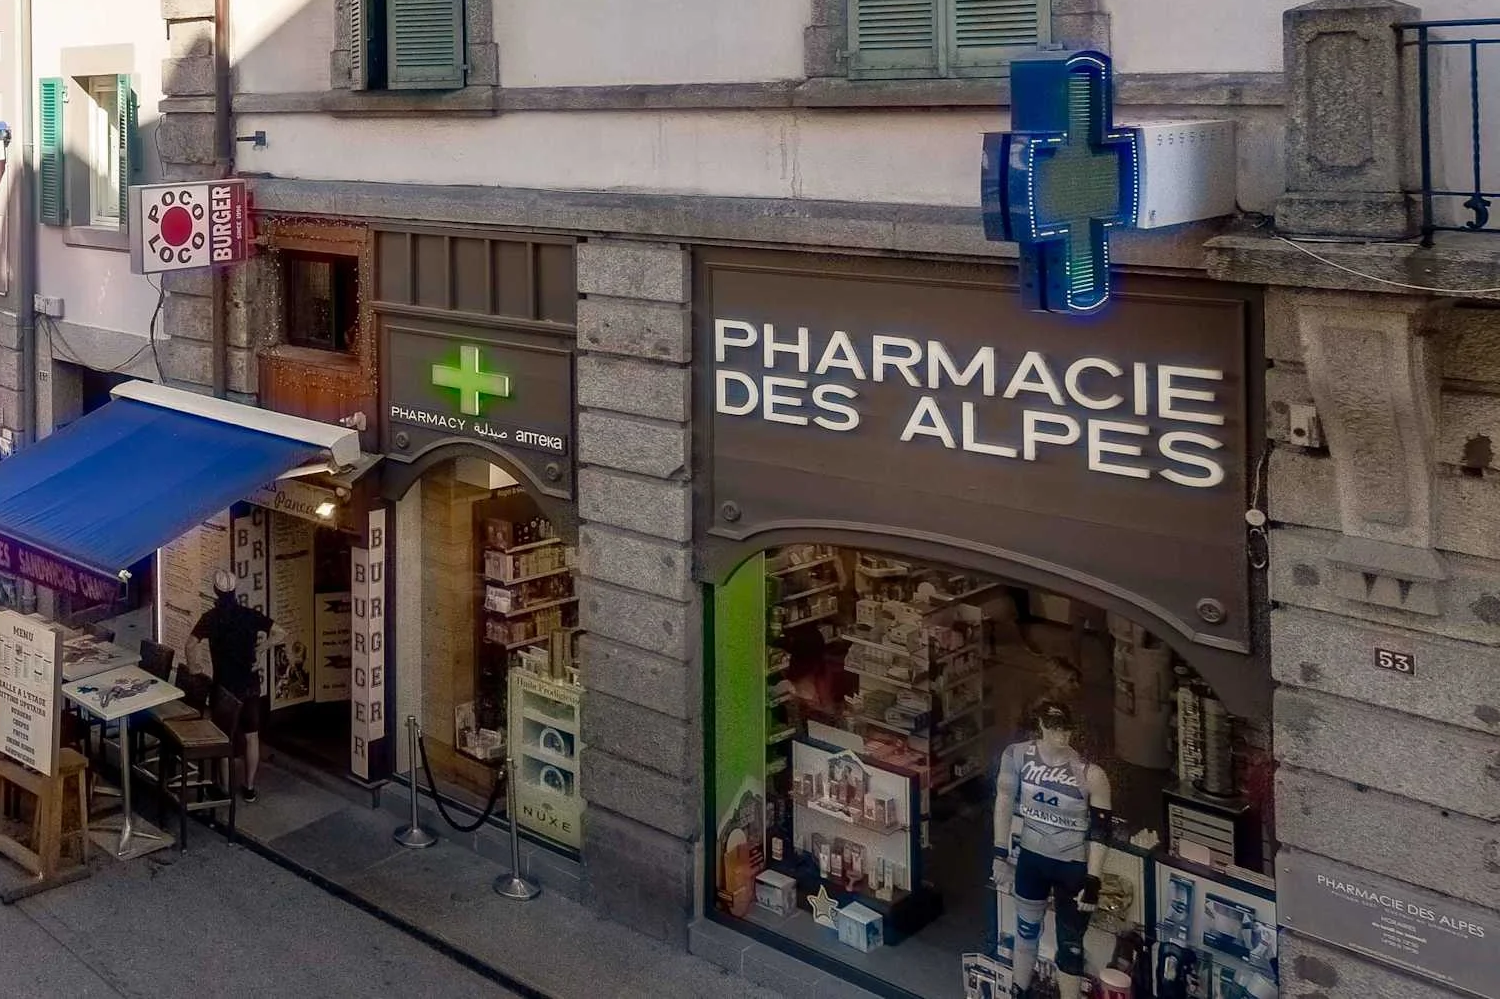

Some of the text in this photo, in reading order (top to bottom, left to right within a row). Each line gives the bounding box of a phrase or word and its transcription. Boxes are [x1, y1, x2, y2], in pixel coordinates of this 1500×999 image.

[148, 190, 204, 224] POCO
[212, 186, 233, 261] BURGER
[148, 232, 205, 263] LOCO
[714, 318, 1225, 426] PHARMACIE
[391, 406, 466, 431] PHARMACY
[715, 368, 1225, 488] DES ALPES
[515, 430, 563, 450] аптека
[13, 625, 34, 642] MENU
[370, 527, 382, 723] BURGER
[354, 563, 366, 757] BURGER
[1379, 651, 1409, 671] 53
[1021, 760, 1080, 787] Milka
[1032, 792, 1059, 806] 44
[523, 805, 572, 833] NUXE
[1317, 874, 1404, 911] PHARMACIE
[1408, 904, 1436, 921] DES
[1439, 915, 1485, 938] ALPES
